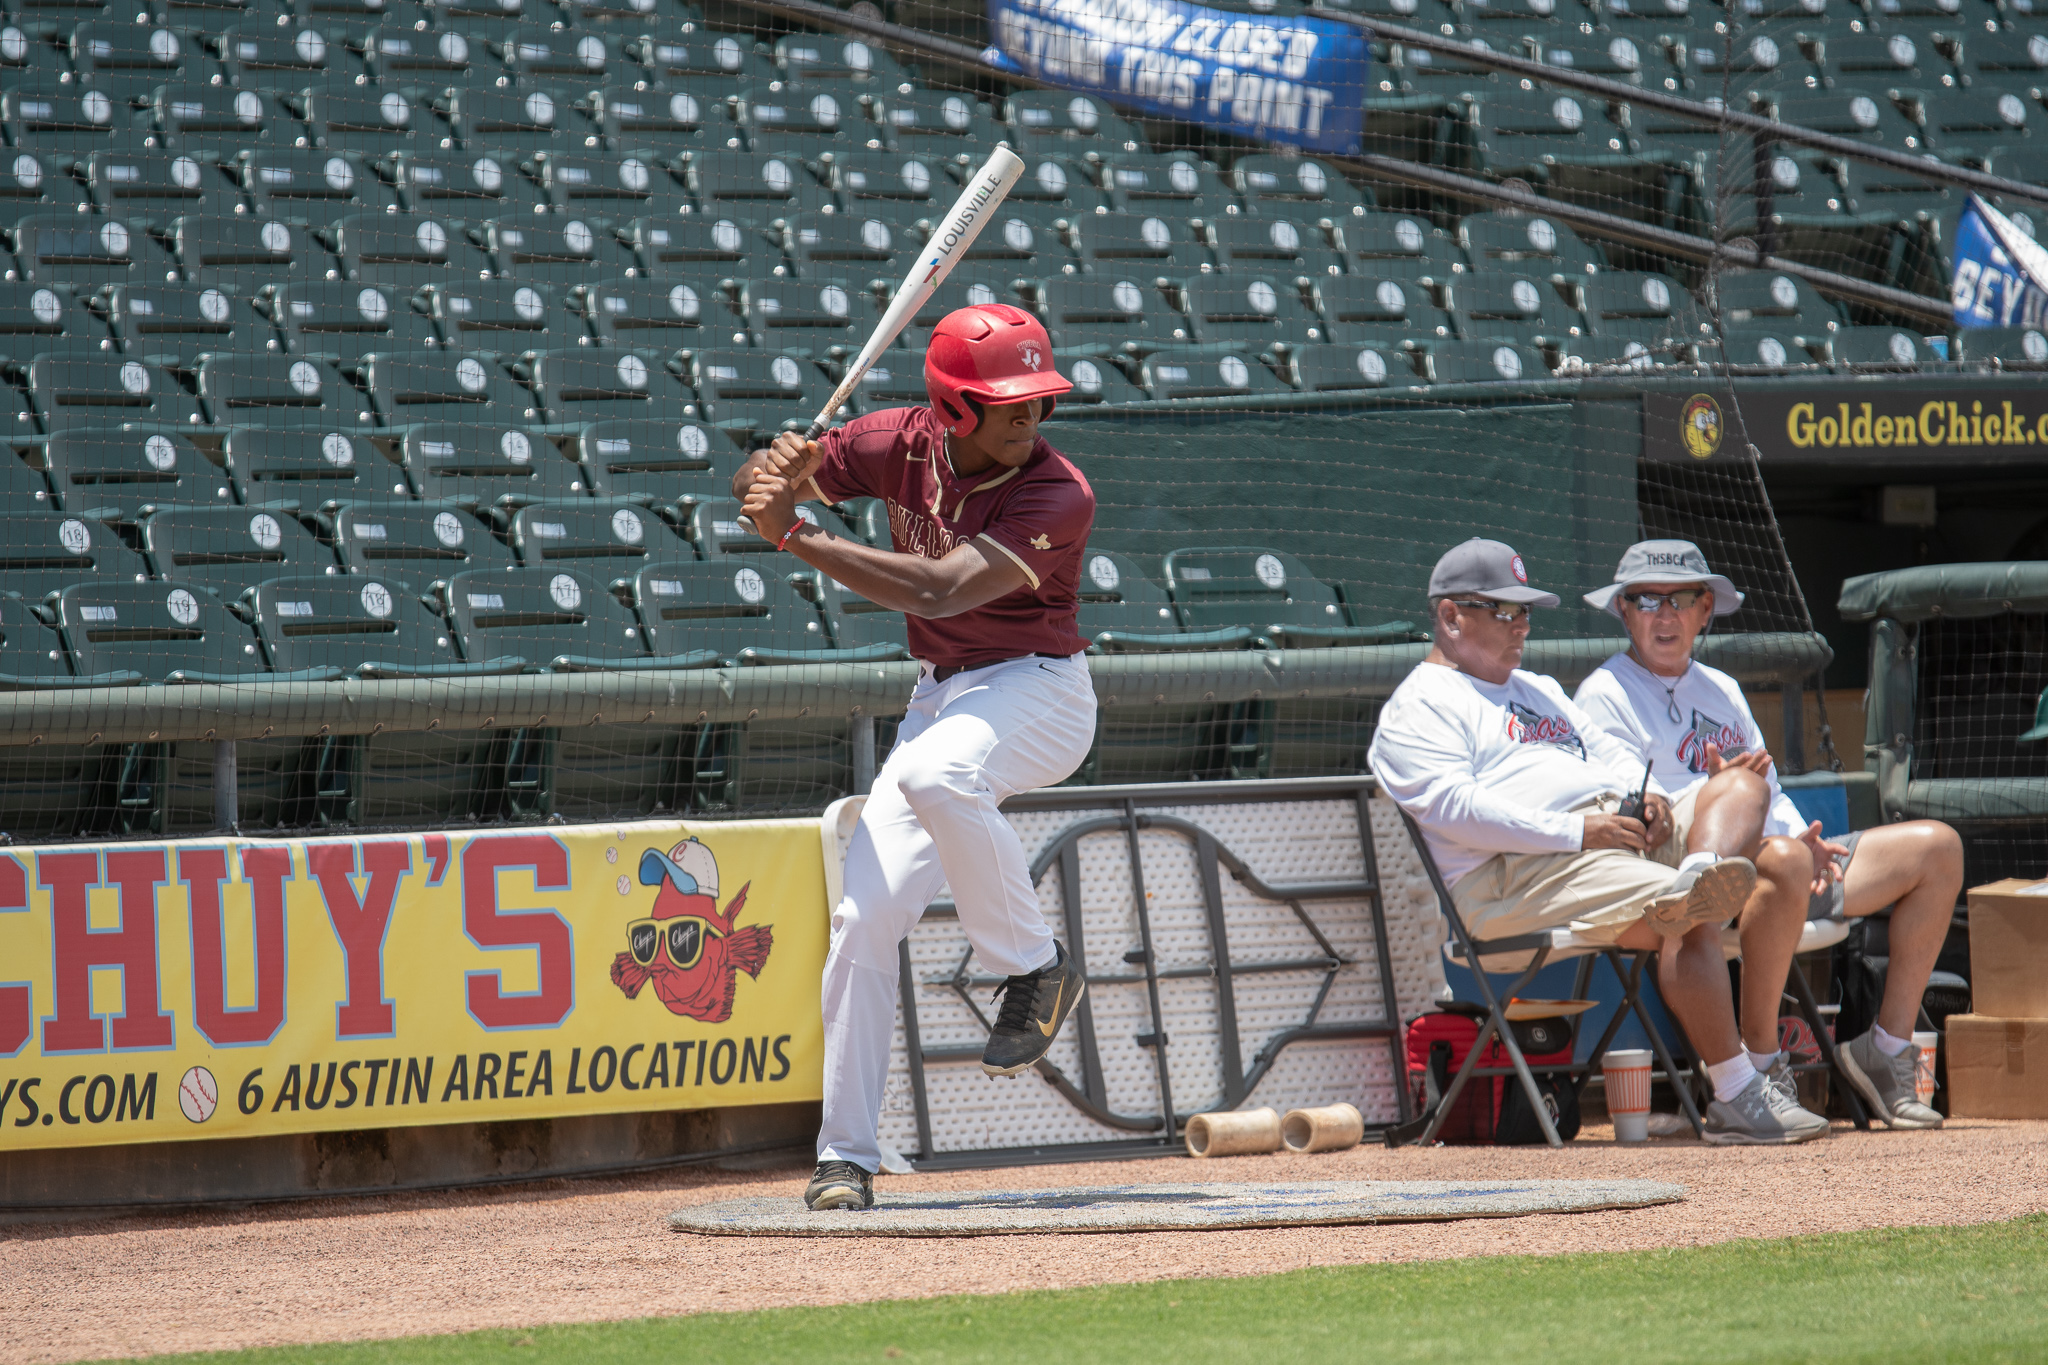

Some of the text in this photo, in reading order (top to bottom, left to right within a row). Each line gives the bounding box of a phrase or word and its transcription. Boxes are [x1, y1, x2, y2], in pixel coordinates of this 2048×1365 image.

[1206, 66, 1334, 140] POINT
[937, 173, 1002, 256] LOUISVILLE
[1952, 257, 2048, 332] BEYO
[67, 528, 83, 542] 18
[257, 524, 272, 537] 17
[1647, 552, 1687, 567] THSBCA
[559, 584, 573, 598] 17
[743, 578, 757, 592] 16
[175, 598, 190, 613] 19
[368, 592, 384, 607] 18
[672, 842, 687, 863] C
[238, 1067, 263, 1115] 6
[271, 1056, 434, 1113] AUSTIN
[441, 1049, 553, 1103] AREA
[566, 1034, 791, 1095] LOCATIONS
